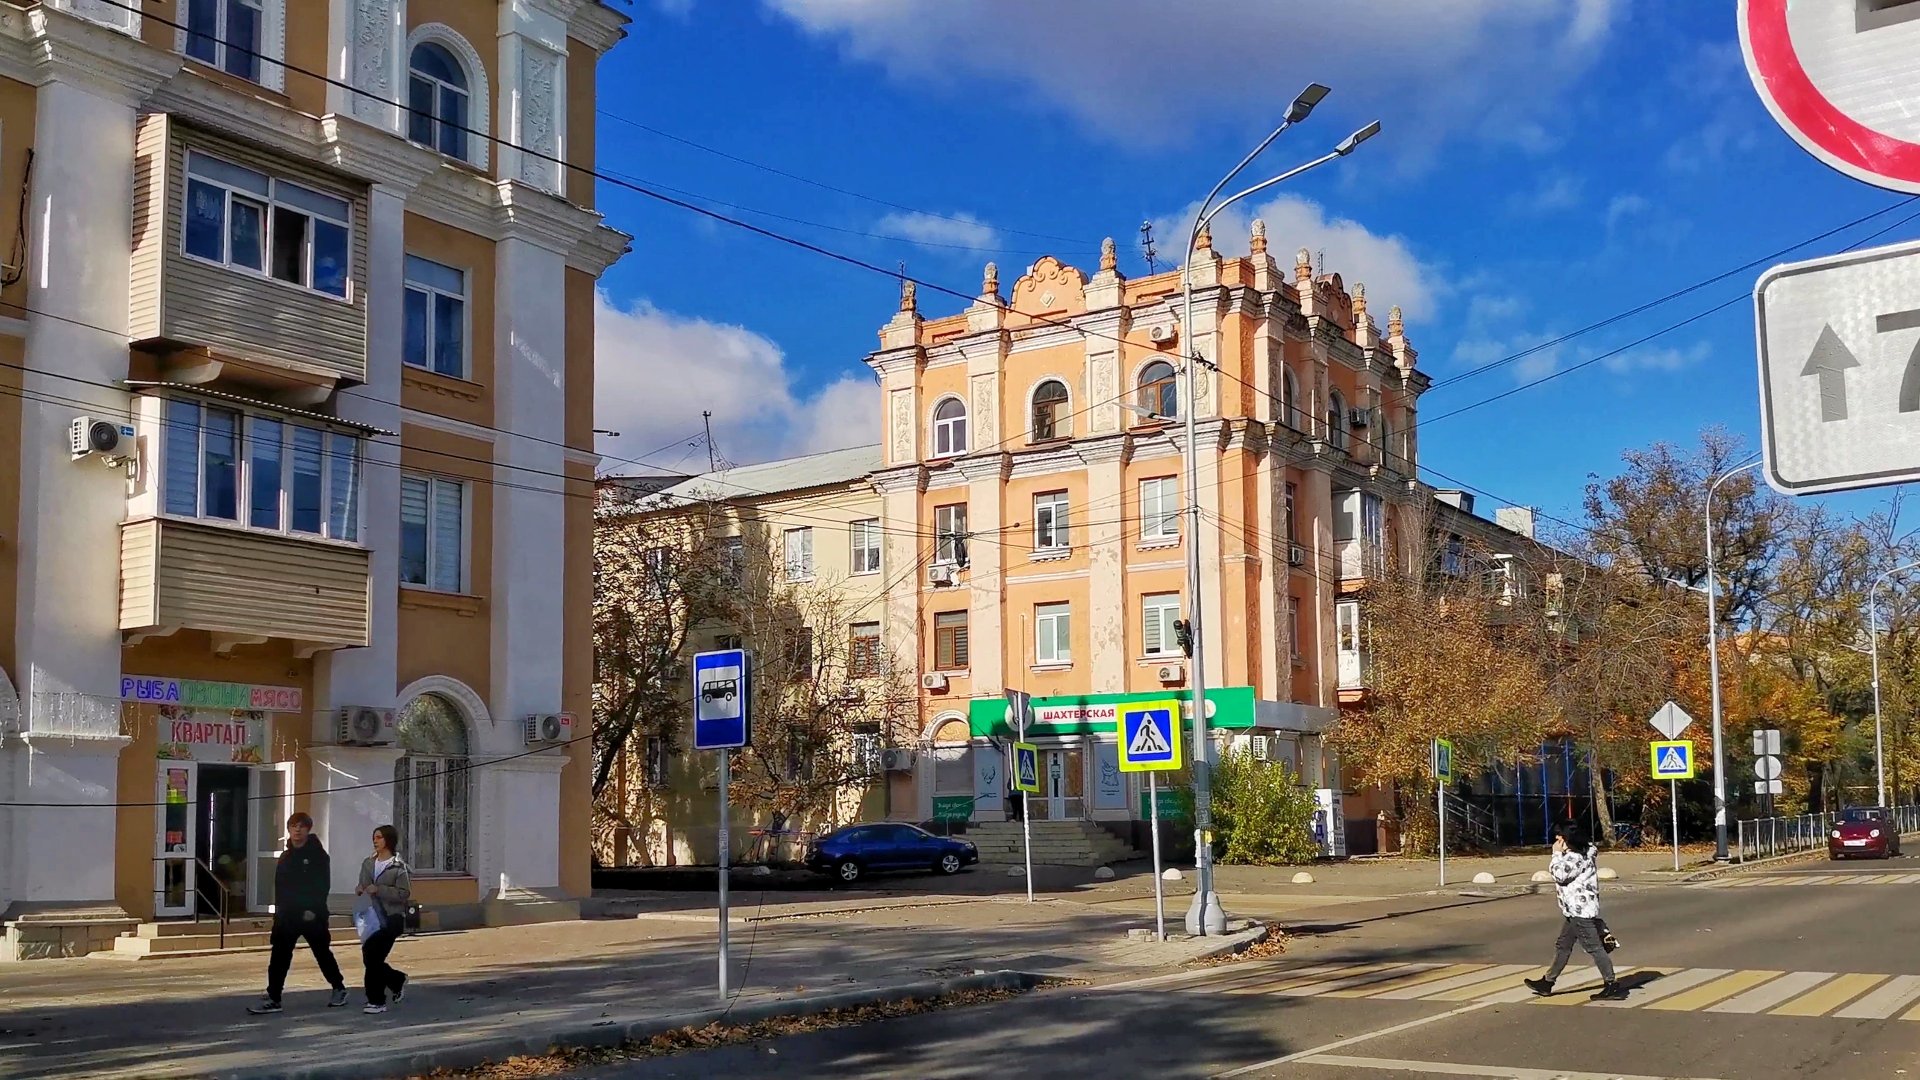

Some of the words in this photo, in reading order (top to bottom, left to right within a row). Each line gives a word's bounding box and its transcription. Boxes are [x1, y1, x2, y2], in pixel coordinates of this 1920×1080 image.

[121, 677, 179, 701] РЫБА
[250, 688, 301, 709] МЯСО
[1043, 708, 1115, 720] ШАХТЕРСКАЯ
[171, 720, 246, 745] КВАРТАЛ
